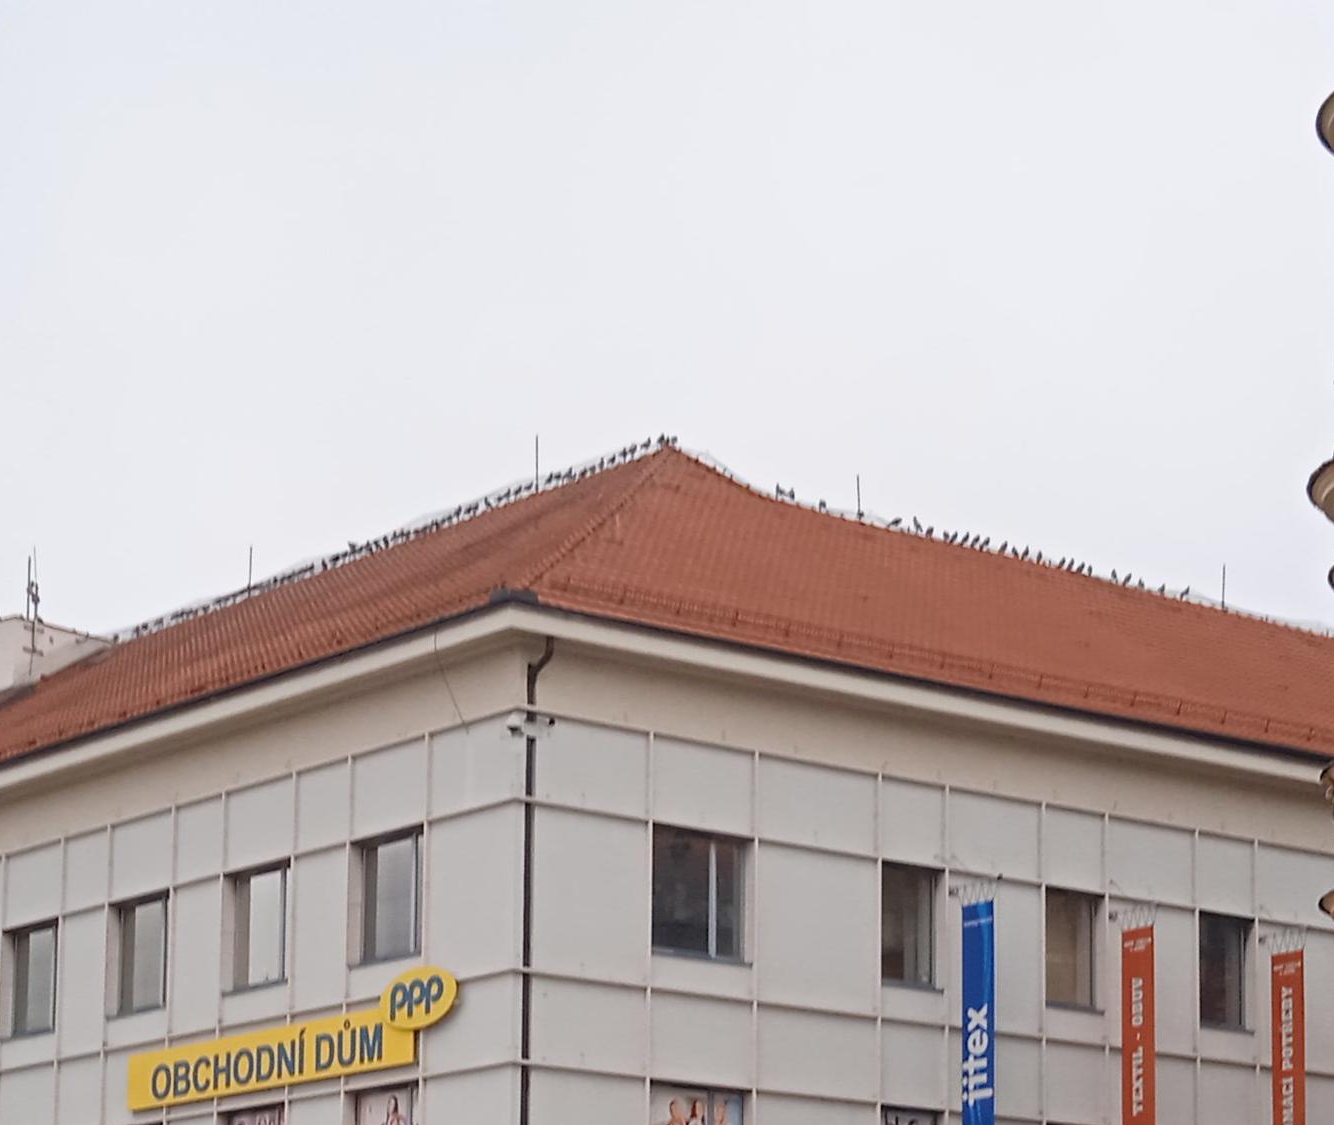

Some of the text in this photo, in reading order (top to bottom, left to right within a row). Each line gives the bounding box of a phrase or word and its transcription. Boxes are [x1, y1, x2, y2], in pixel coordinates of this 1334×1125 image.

[151, 1019, 384, 1099] OBCHODNÍ DŮM
[962, 1002, 994, 1107] jitex
[1131, 1046, 1144, 1117] TEXTIL
